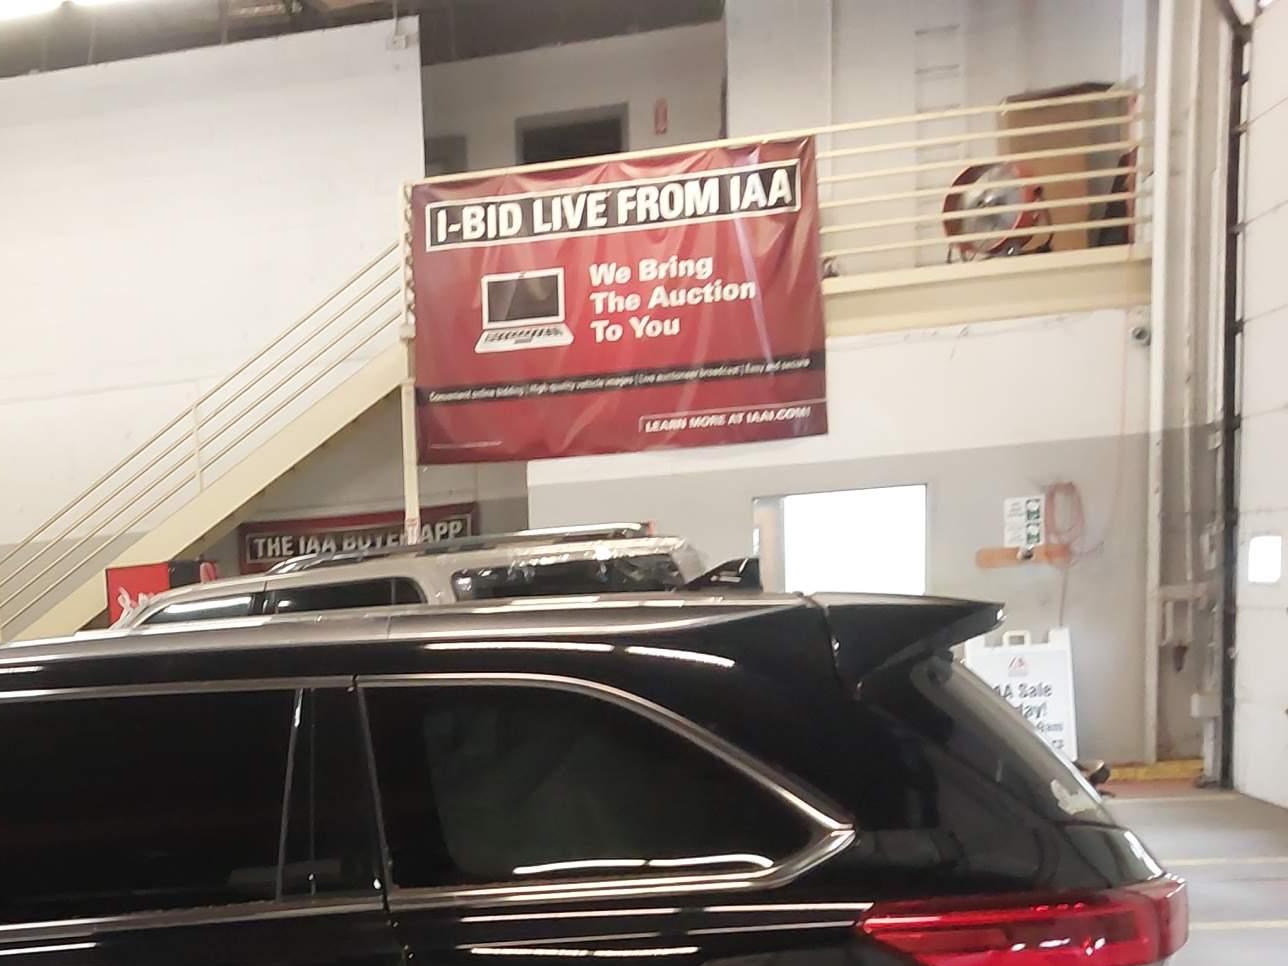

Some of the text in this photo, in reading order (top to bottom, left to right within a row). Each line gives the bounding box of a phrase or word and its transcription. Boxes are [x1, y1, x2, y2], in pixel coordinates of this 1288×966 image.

[437, 168, 793, 243] I-BID LIVE FROM IAA
[589, 255, 713, 287] We Bring
[589, 279, 756, 314] The Auction
[590, 315, 681, 343] To You
[645, 417, 687, 433] LEARN
[688, 414, 726, 428] MORE
[727, 412, 744, 425] AT
[253, 536, 294, 559] THE
[299, 534, 339, 555] IAA
[421, 519, 463, 543] APP
[1018, 682, 1053, 699] Sale
